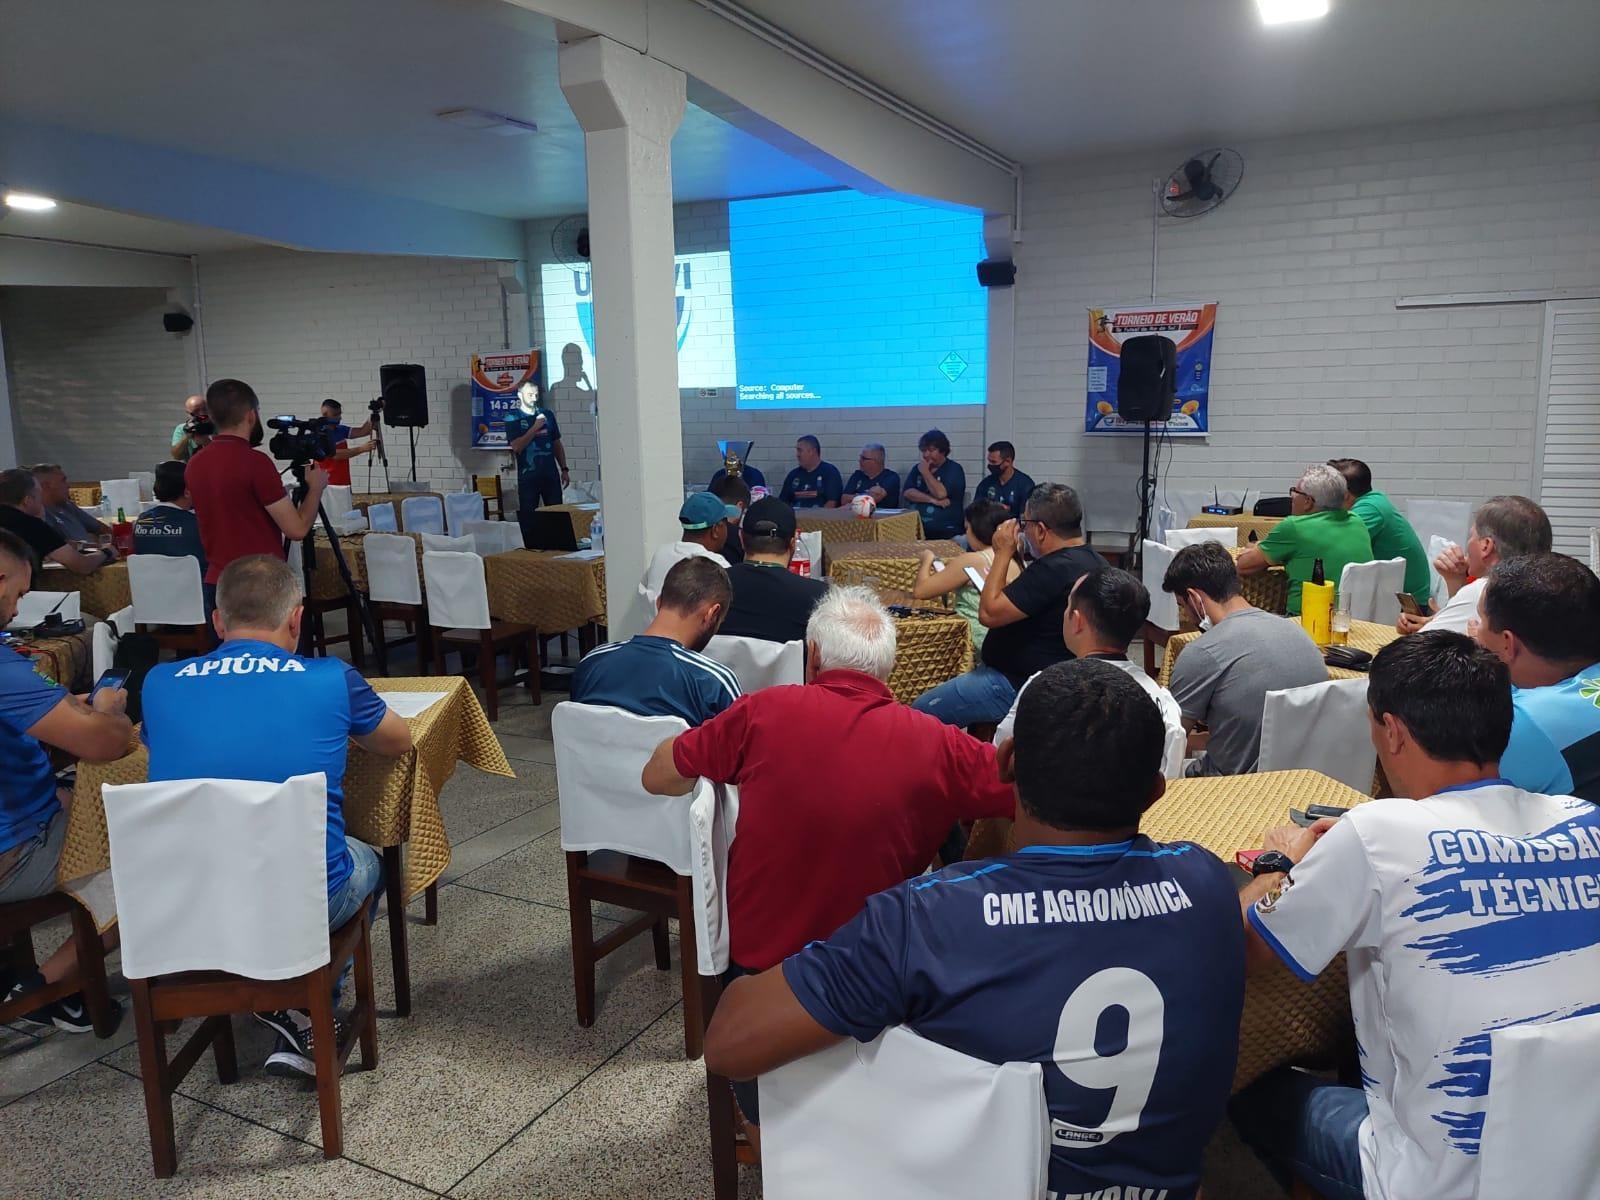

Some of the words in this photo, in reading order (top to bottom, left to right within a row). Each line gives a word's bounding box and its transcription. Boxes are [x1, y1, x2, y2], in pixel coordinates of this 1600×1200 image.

[1117, 313, 1155, 325] TORNEIO
[1155, 312, 1168, 324] DE
[1169, 311, 1199, 323] VERÃO
[739, 384, 767, 392] Source:
[770, 383, 804, 392] Computer
[739, 392, 775, 400] Searching
[776, 392, 785, 400] all
[490, 400, 501, 410] 14
[502, 402, 509, 410] a
[135, 524, 147, 535] Rio
[149, 526, 162, 535] do
[163, 524, 183, 535] Sul
[174, 652, 306, 677] APIÚNA
[1460, 872, 1600, 914] TÉCNIC
[983, 892, 1039, 926] CME
[1043, 877, 1193, 923] AGRONÔMICA
[1053, 966, 1165, 1148] 9
